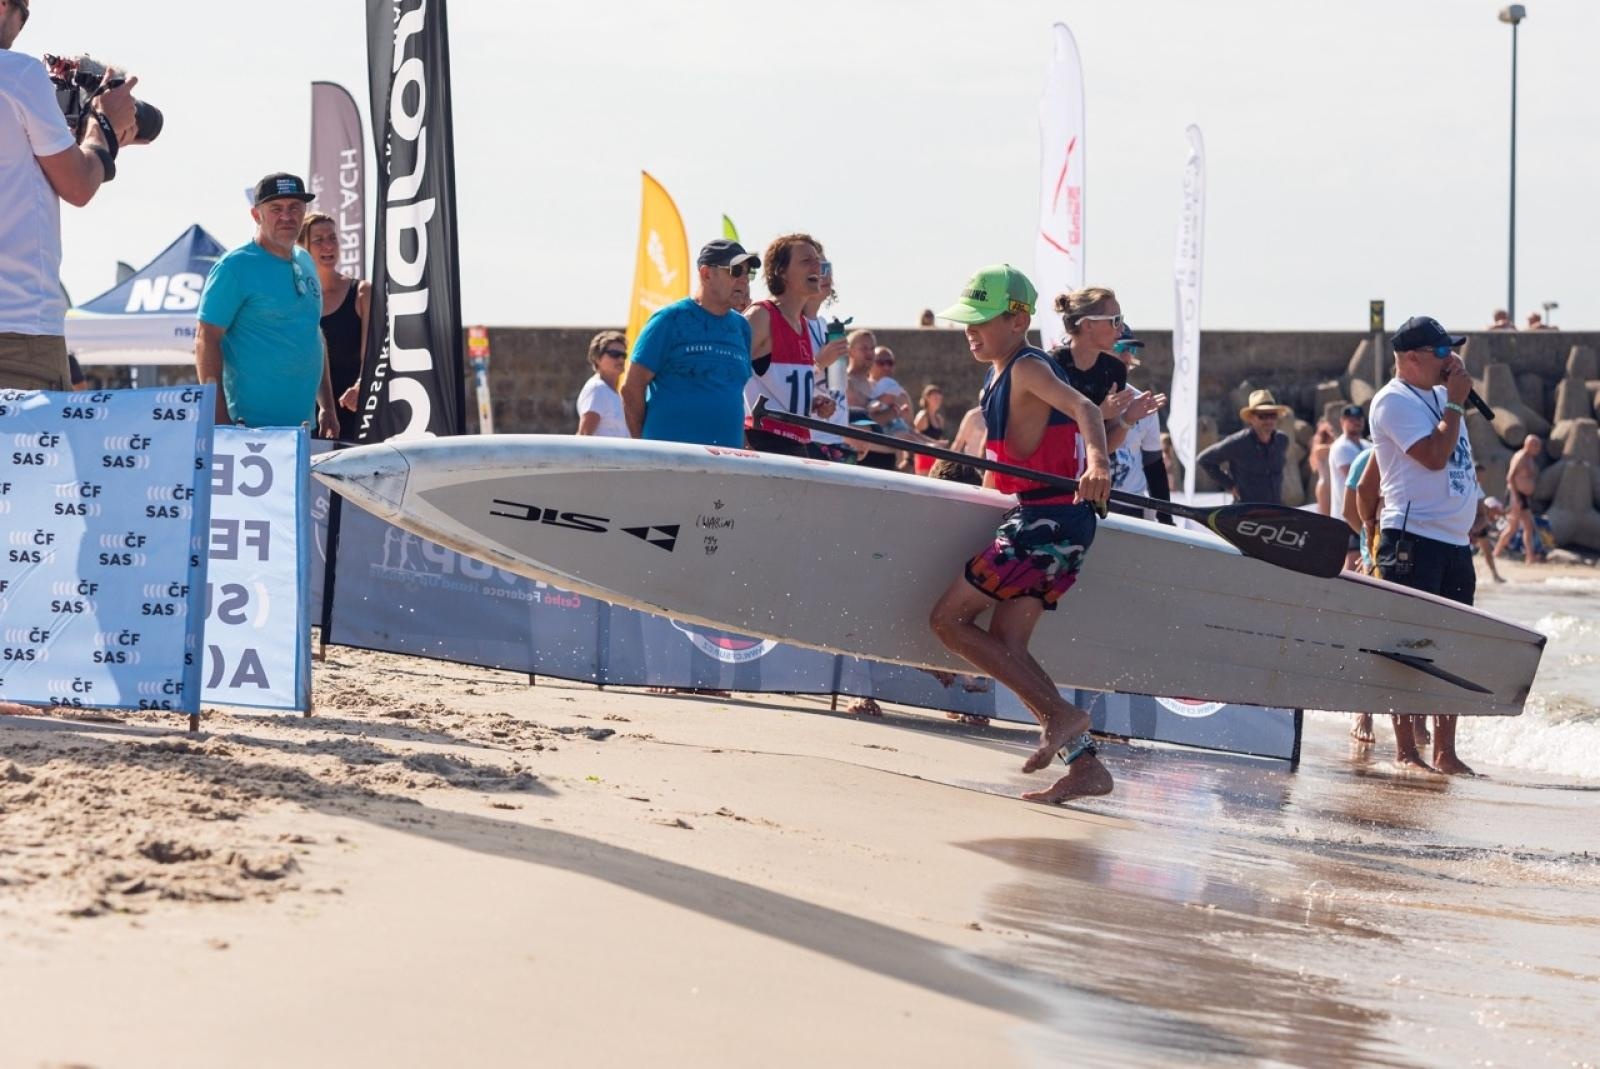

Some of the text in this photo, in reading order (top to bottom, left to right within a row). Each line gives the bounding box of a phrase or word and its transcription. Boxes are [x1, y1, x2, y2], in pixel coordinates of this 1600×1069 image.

[181, 386, 204, 403] ČF
[62, 407, 95, 420] SAS
[152, 408, 186, 421] SAS
[38, 431, 60, 448] ČF
[129, 434, 152, 450] ČF
[12, 452, 45, 465] SAS
[102, 455, 136, 468] SAS
[80, 481, 102, 498] ČF
[172, 483, 195, 500] ČF
[54, 503, 87, 516] SAS
[146, 505, 180, 518] SAS
[34, 529, 55, 545] ČF
[125, 531, 147, 548] ČF
[9, 549, 41, 563] SAS
[99, 553, 132, 566] SAS
[77, 580, 99, 596] ČF
[168, 582, 191, 598] ČF
[51, 600, 84, 613] SAS
[142, 603, 175, 616] SAS
[29, 626, 51, 643] ČF
[118, 630, 141, 646] ČF
[3, 648, 36, 661] SAS
[93, 651, 126, 664] SAS
[72, 677, 93, 693] ČF
[162, 679, 185, 695] ČF
[139, 699, 171, 711] SAS
